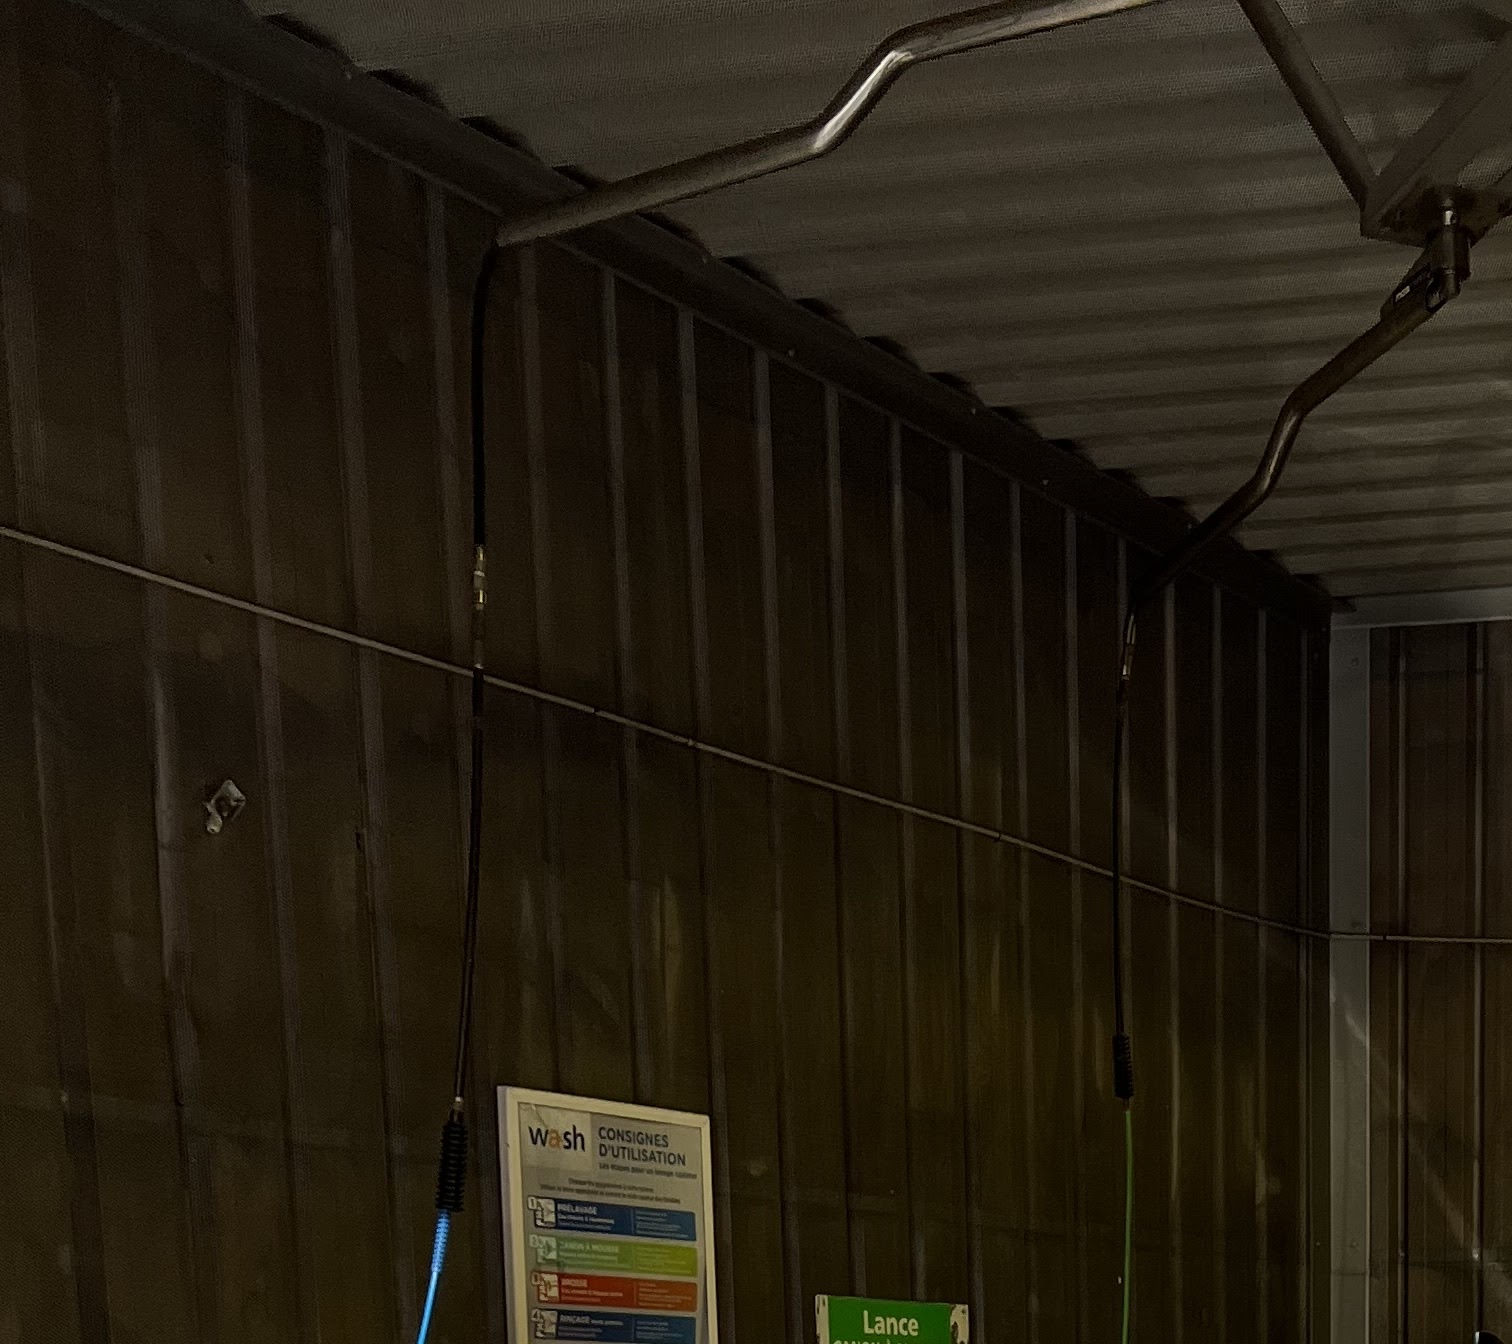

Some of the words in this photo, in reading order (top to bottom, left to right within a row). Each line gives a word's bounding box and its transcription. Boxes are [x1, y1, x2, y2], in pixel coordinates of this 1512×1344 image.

[528, 1124, 586, 1153] wash
[598, 1126, 669, 1149] CONSIGNES
[598, 1143, 687, 1167] D'UTILISATION
[863, 1310, 919, 1336] Lance
